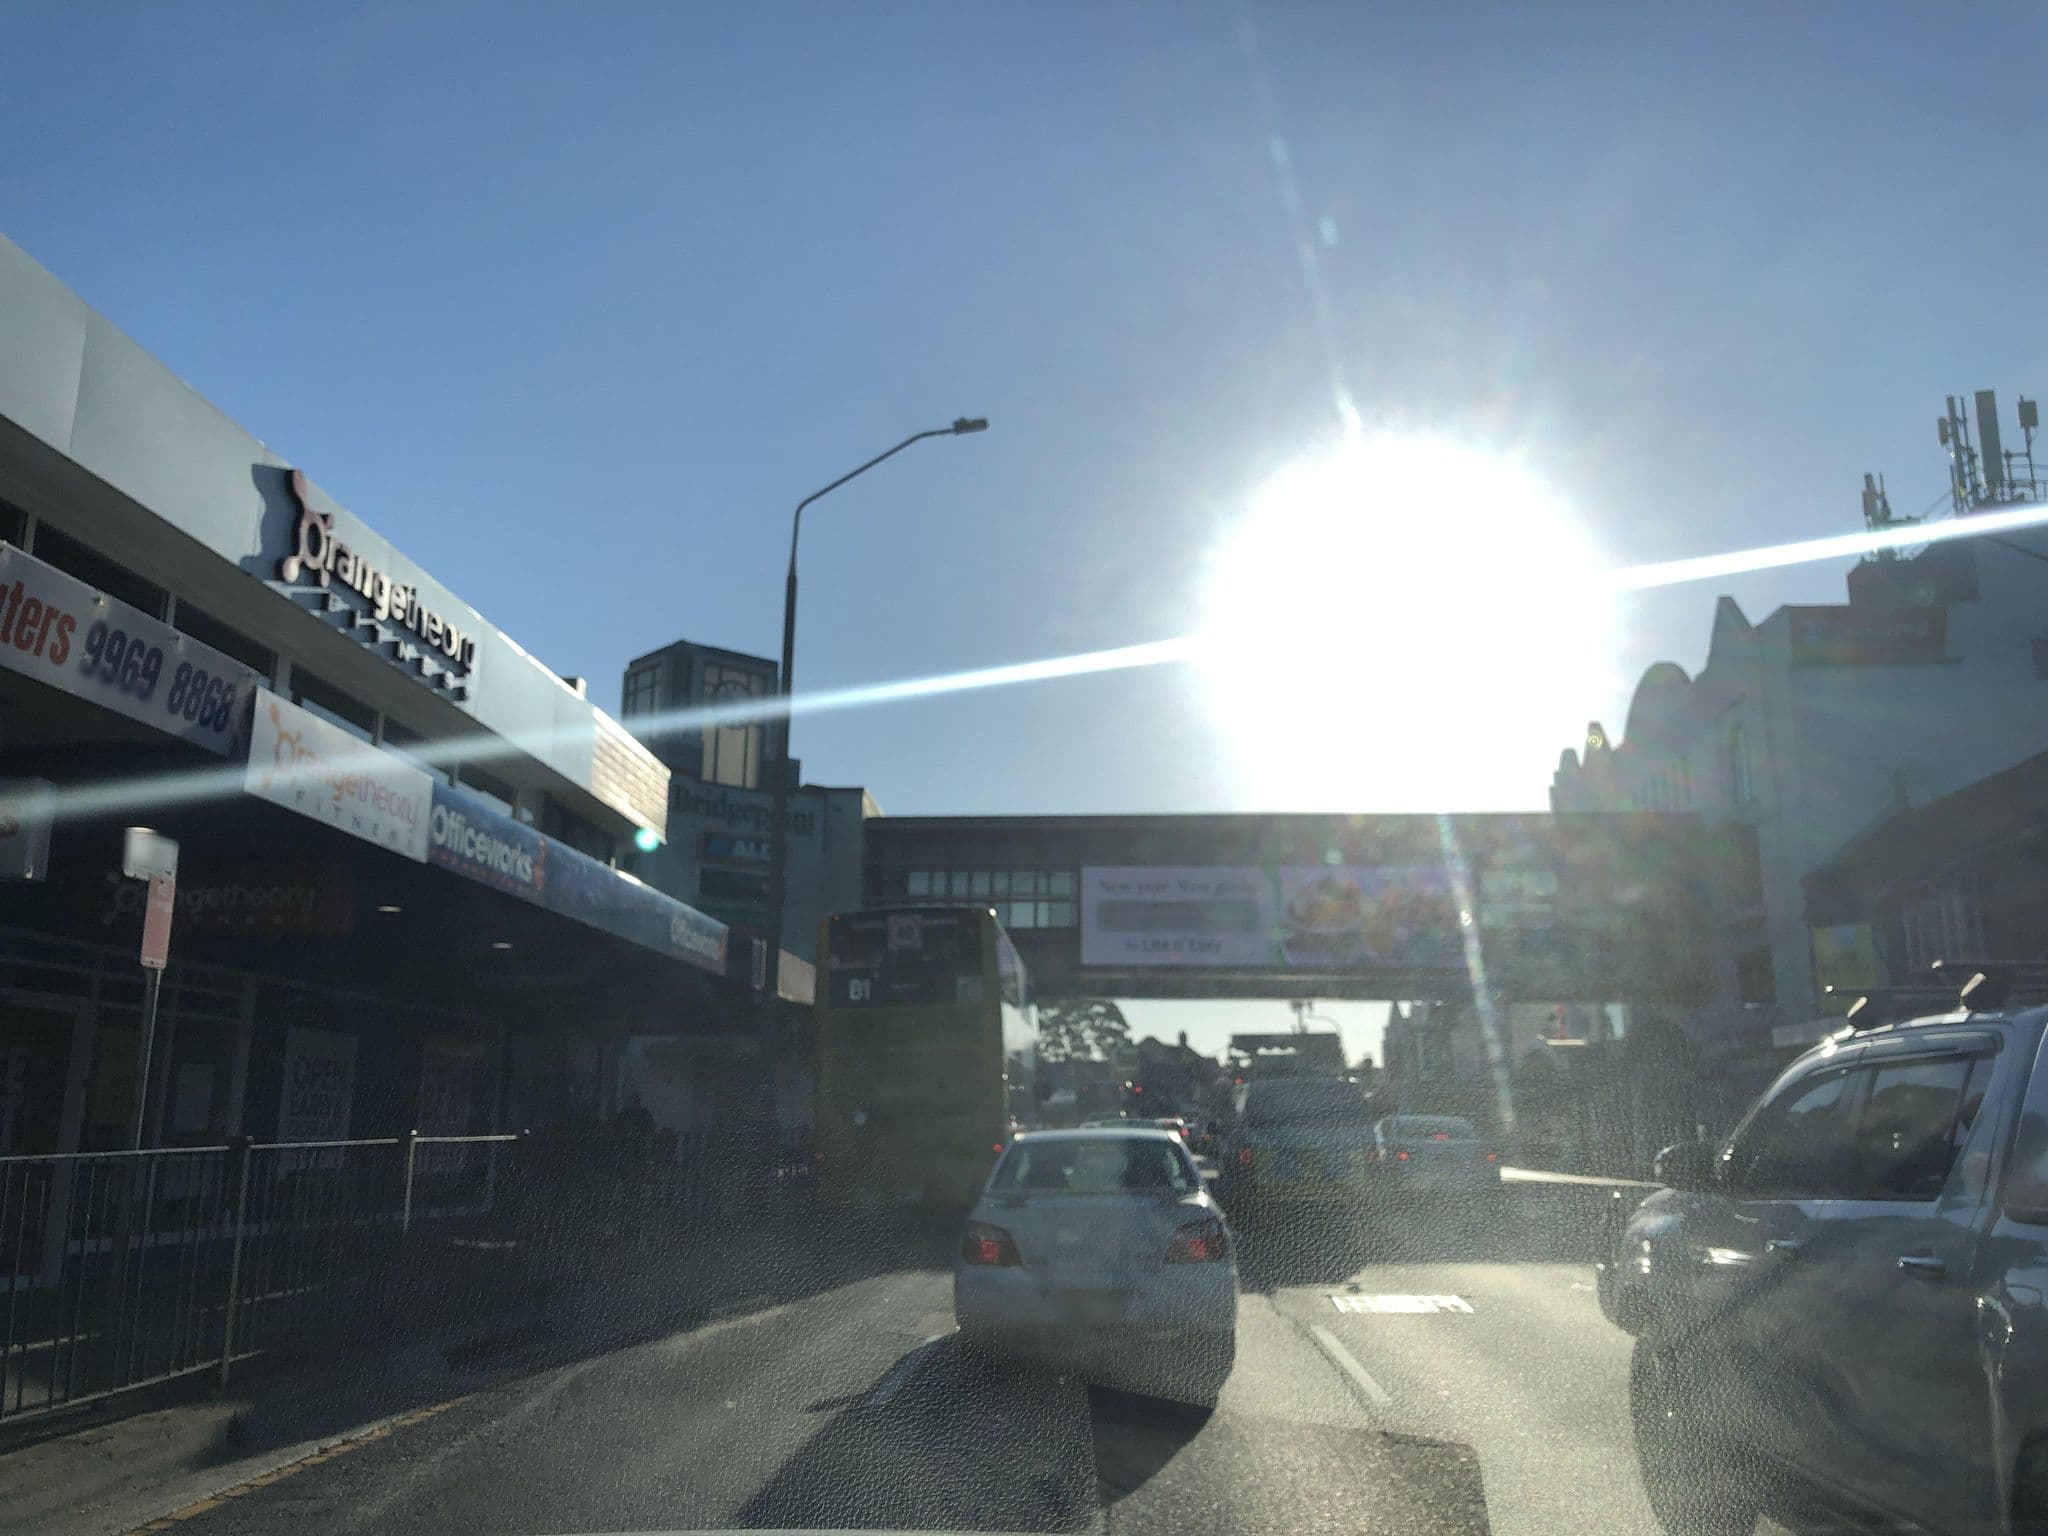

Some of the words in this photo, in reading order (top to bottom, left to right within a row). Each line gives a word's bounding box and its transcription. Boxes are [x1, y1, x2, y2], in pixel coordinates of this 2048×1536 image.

[80, 618, 164, 702] 9969
[167, 661, 237, 733] 8868
[432, 804, 534, 883] Officeworks
